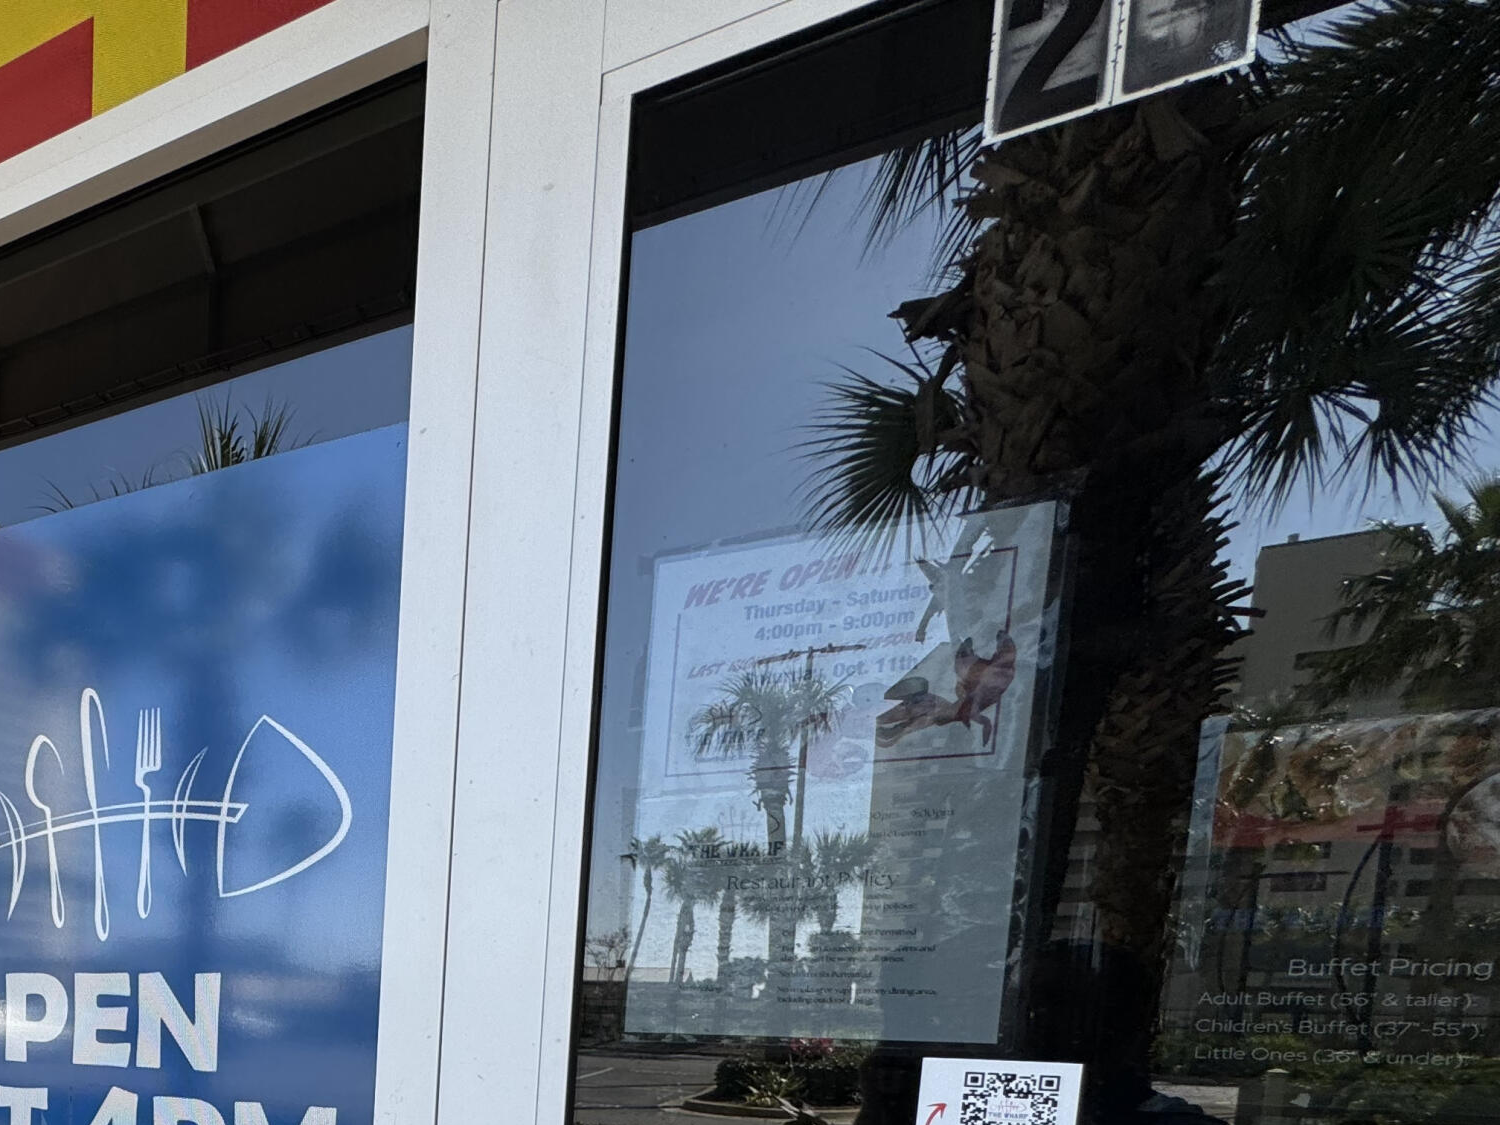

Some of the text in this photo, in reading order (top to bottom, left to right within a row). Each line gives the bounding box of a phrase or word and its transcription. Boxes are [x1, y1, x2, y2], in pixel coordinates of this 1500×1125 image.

[683, 569, 773, 610] WE'RE
[744, 599, 825, 620] Thursday
[846, 583, 930, 607] Saturday
[754, 622, 823, 641] 4:00pm
[843, 611, 915, 631] 9:00pm
[833, 659, 869, 678] Oct.
[1287, 957, 1494, 981] Buffet Pricing
[1198, 991, 1250, 1007] Adult
[1256, 991, 1326, 1007] Buffet
[1381, 993, 1398, 1007] &
[1194, 1018, 1293, 1035] Children's
[1298, 1019, 1368, 1036] Buffet
[1193, 1046, 1246, 1061] Little
[1251, 1047, 1308, 1063] Ones
